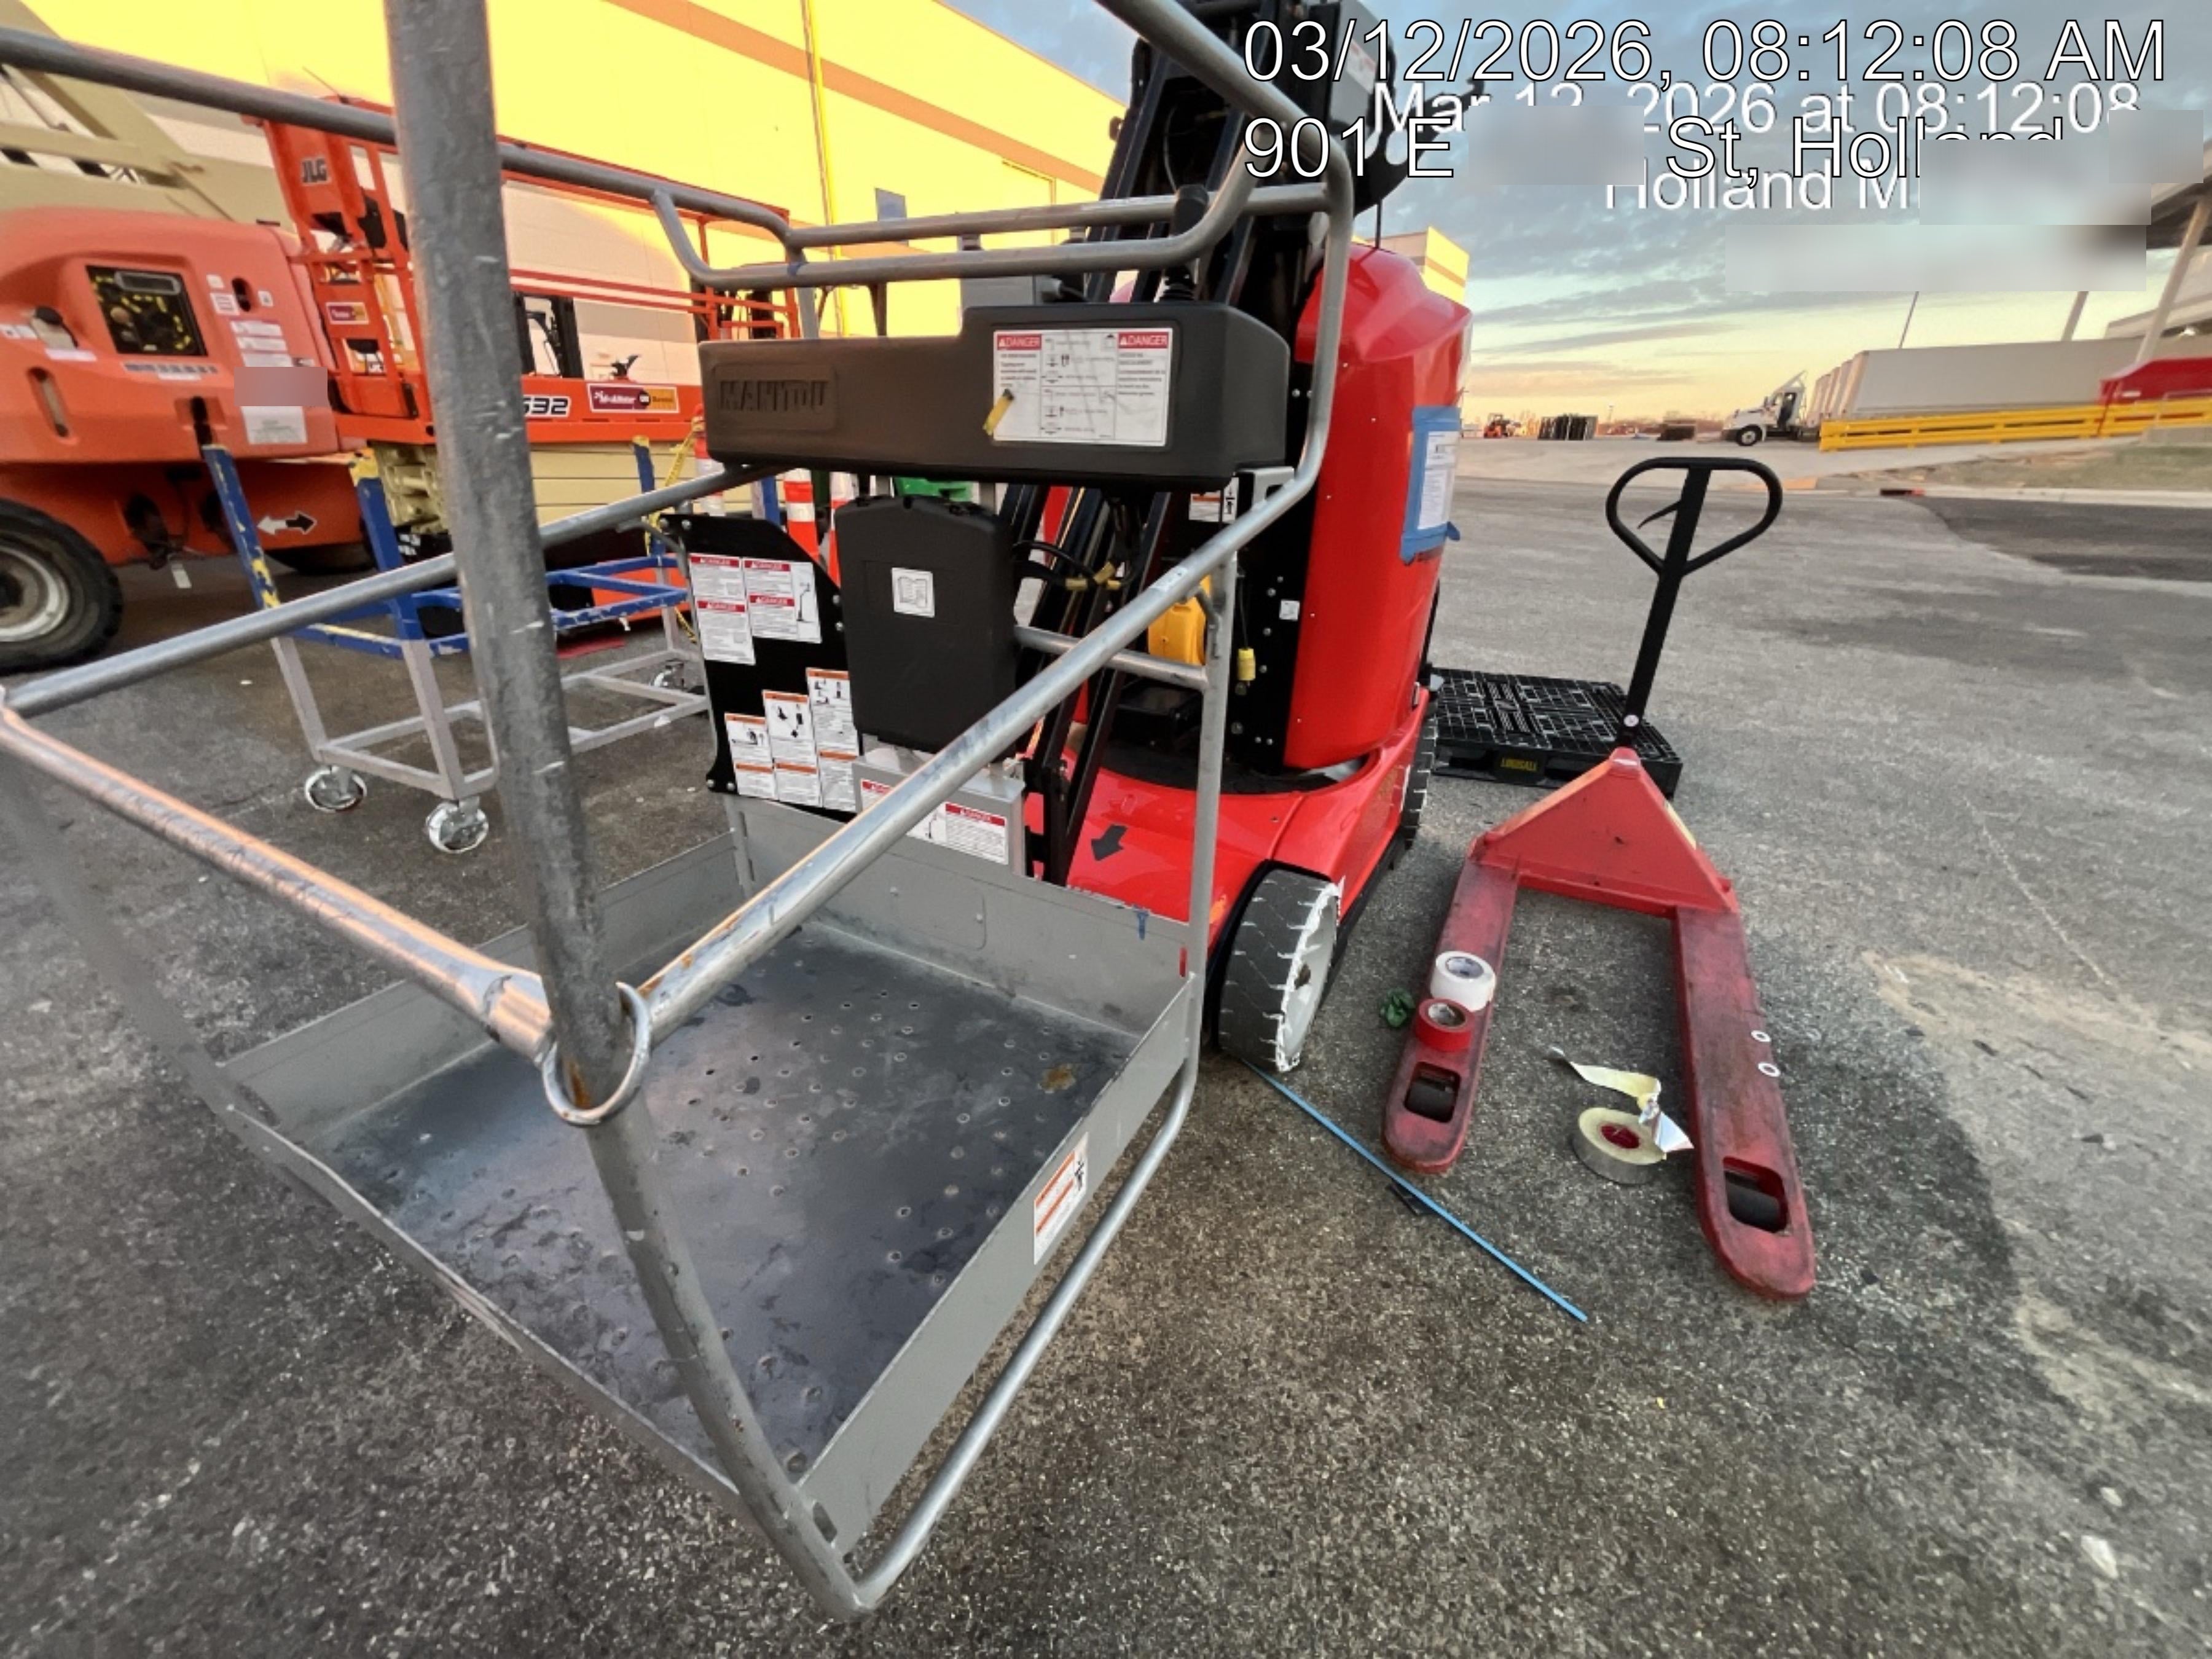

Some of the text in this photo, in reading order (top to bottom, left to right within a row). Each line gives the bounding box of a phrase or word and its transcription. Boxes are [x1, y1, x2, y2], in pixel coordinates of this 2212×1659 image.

[302, 158, 327, 183] JLG
[1005, 335, 1040, 347] DANGER
[1126, 334, 1169, 346] DANGER
